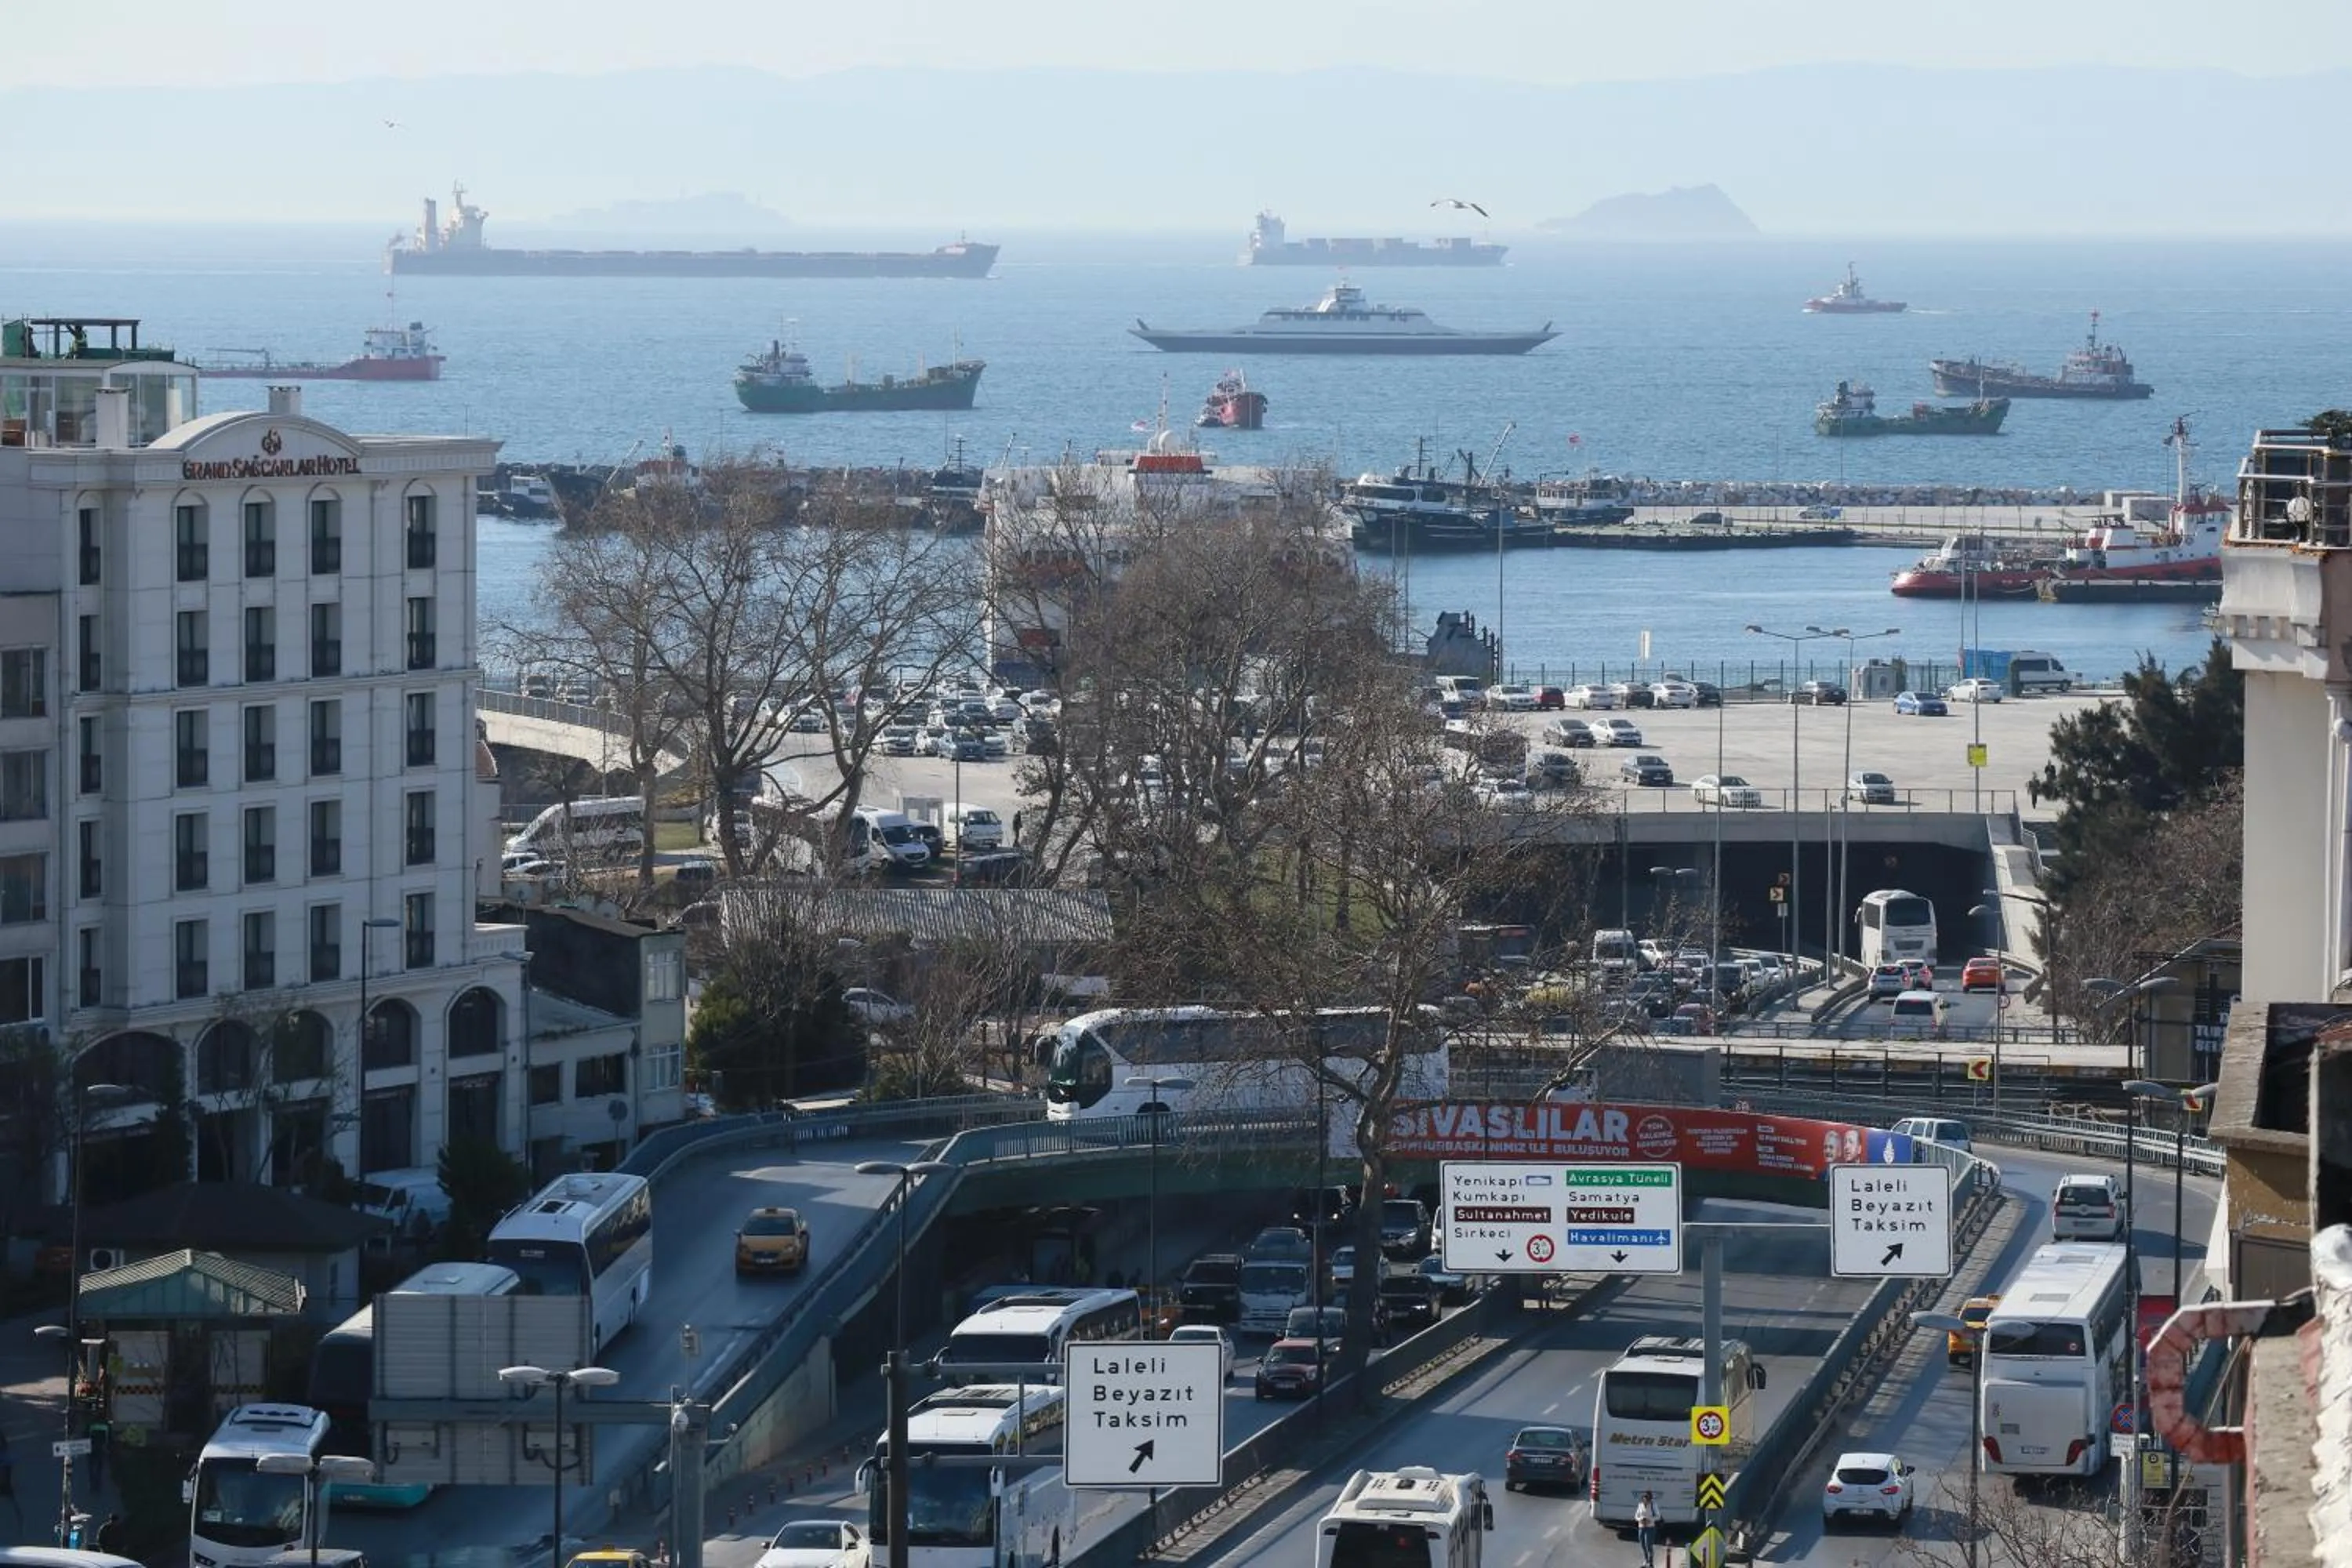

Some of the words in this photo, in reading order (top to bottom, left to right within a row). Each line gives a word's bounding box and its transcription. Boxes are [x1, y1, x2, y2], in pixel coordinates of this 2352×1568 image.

[182, 459, 231, 480] GRAND
[317, 454, 361, 474] HOTEL
[1569, 1173, 1624, 1185] Avrasya
[1629, 1173, 1668, 1183] Tüneli
[1851, 1179, 1907, 1192] Laleli
[1453, 1192, 1525, 1203] Kumkapı
[1569, 1191, 1639, 1204] Samatya
[1851, 1199, 1933, 1215] Beyazıt
[1457, 1209, 1548, 1220] Sultanahmet
[1570, 1210, 1632, 1221] Yedikule
[1852, 1218, 1926, 1232] Taksim
[1570, 1232, 1653, 1243] Havalimanı
[1094, 1358, 1166, 1374] Laleli
[1093, 1385, 1194, 1406] Beyazıt
[1093, 1412, 1188, 1428] Taksim
